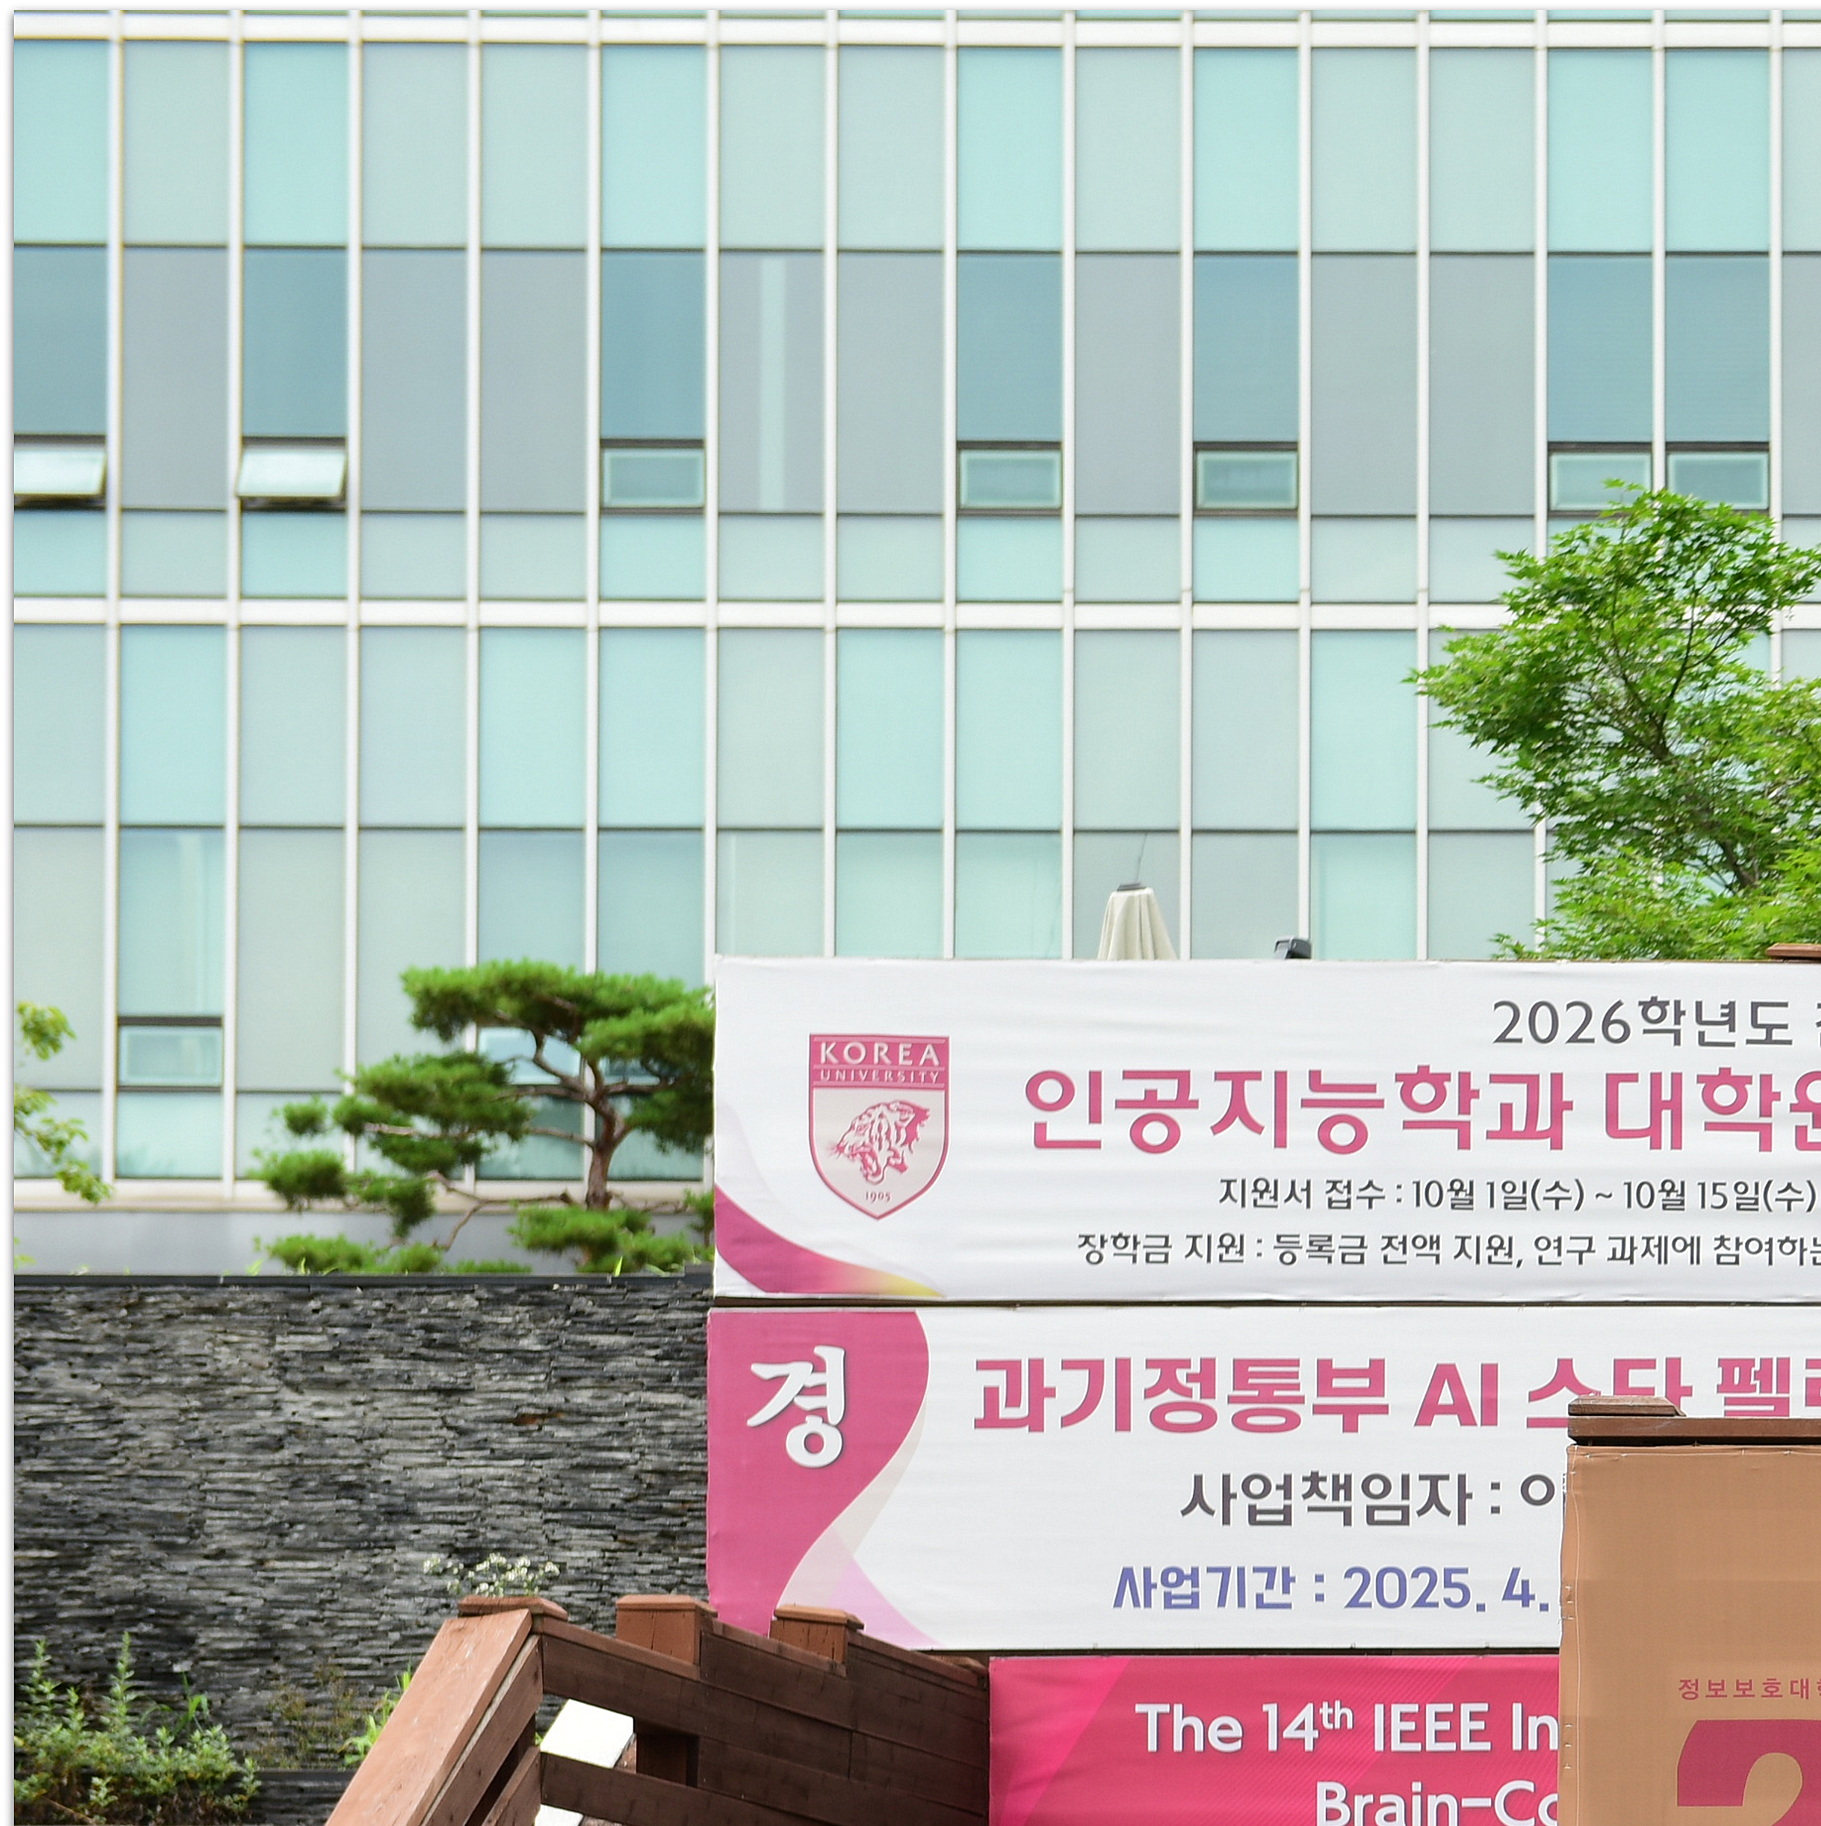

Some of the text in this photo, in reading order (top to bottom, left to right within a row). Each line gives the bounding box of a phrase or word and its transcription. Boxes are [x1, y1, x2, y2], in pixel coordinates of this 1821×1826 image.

[1493, 995, 1793, 1048] 2026학년도
[818, 1040, 942, 1067] KOREA
[820, 1068, 941, 1085] UNIVERSITY
[1024, 1064, 1574, 1155] 인공지능학과
[1219, 1177, 1311, 1210] 지원서
[1325, 1179, 1386, 1210] 접수
[1412, 1178, 1474, 1211] 10월
[1486, 1178, 1585, 1212] 1일(수)
[1623, 1179, 1686, 1212] 10월
[1697, 1179, 1816, 1213] 15일(수)
[1077, 1232, 1173, 1265] 장학금
[1184, 1232, 1245, 1264] 지원
[1273, 1234, 1368, 1266] 등록금
[1380, 1234, 1441, 1265] 전액
[1453, 1234, 1523, 1269] 지원,
[1534, 1235, 1596, 1266] 연구
[1606, 1235, 1701, 1266] 과제에
[746, 1345, 847, 1468] 경
[973, 1357, 1390, 1434] 과기정통부
[1413, 1362, 1499, 1427] AI
[1180, 1470, 1473, 1527] 사업책임자
[1112, 1566, 1296, 1610] 사업기간
[1343, 1566, 1486, 1613] 2025.
[1501, 1567, 1549, 1612] 4.
[1134, 1703, 1245, 1752] The
[1262, 1700, 1355, 1752] 14th
[1374, 1702, 1492, 1752] IEEE
